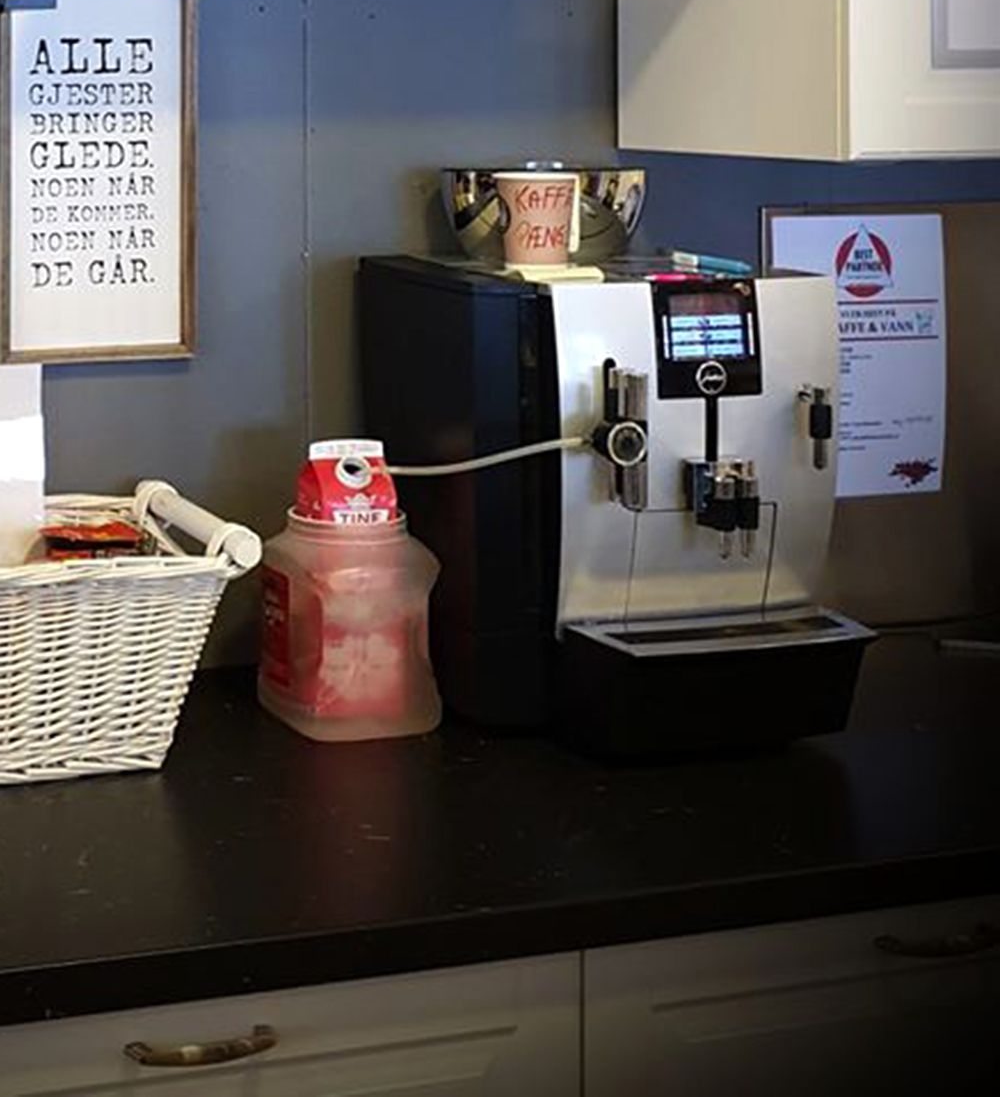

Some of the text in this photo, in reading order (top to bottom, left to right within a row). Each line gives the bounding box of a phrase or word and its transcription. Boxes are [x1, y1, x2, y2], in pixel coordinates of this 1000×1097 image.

[29, 37, 154, 75] ALLE
[28, 82, 154, 106] GJESTER
[30, 111, 154, 135] BRINGER
[29, 140, 155, 170] GLEDE.
[30, 172, 155, 197] NOEN NÅR
[31, 203, 154, 224] DE KOMMER.
[31, 226, 155, 252] NOEN NÅR
[31, 254, 155, 288] DE GÅR.
[838, 322, 866, 334] AFFE
[867, 322, 878, 333] &
